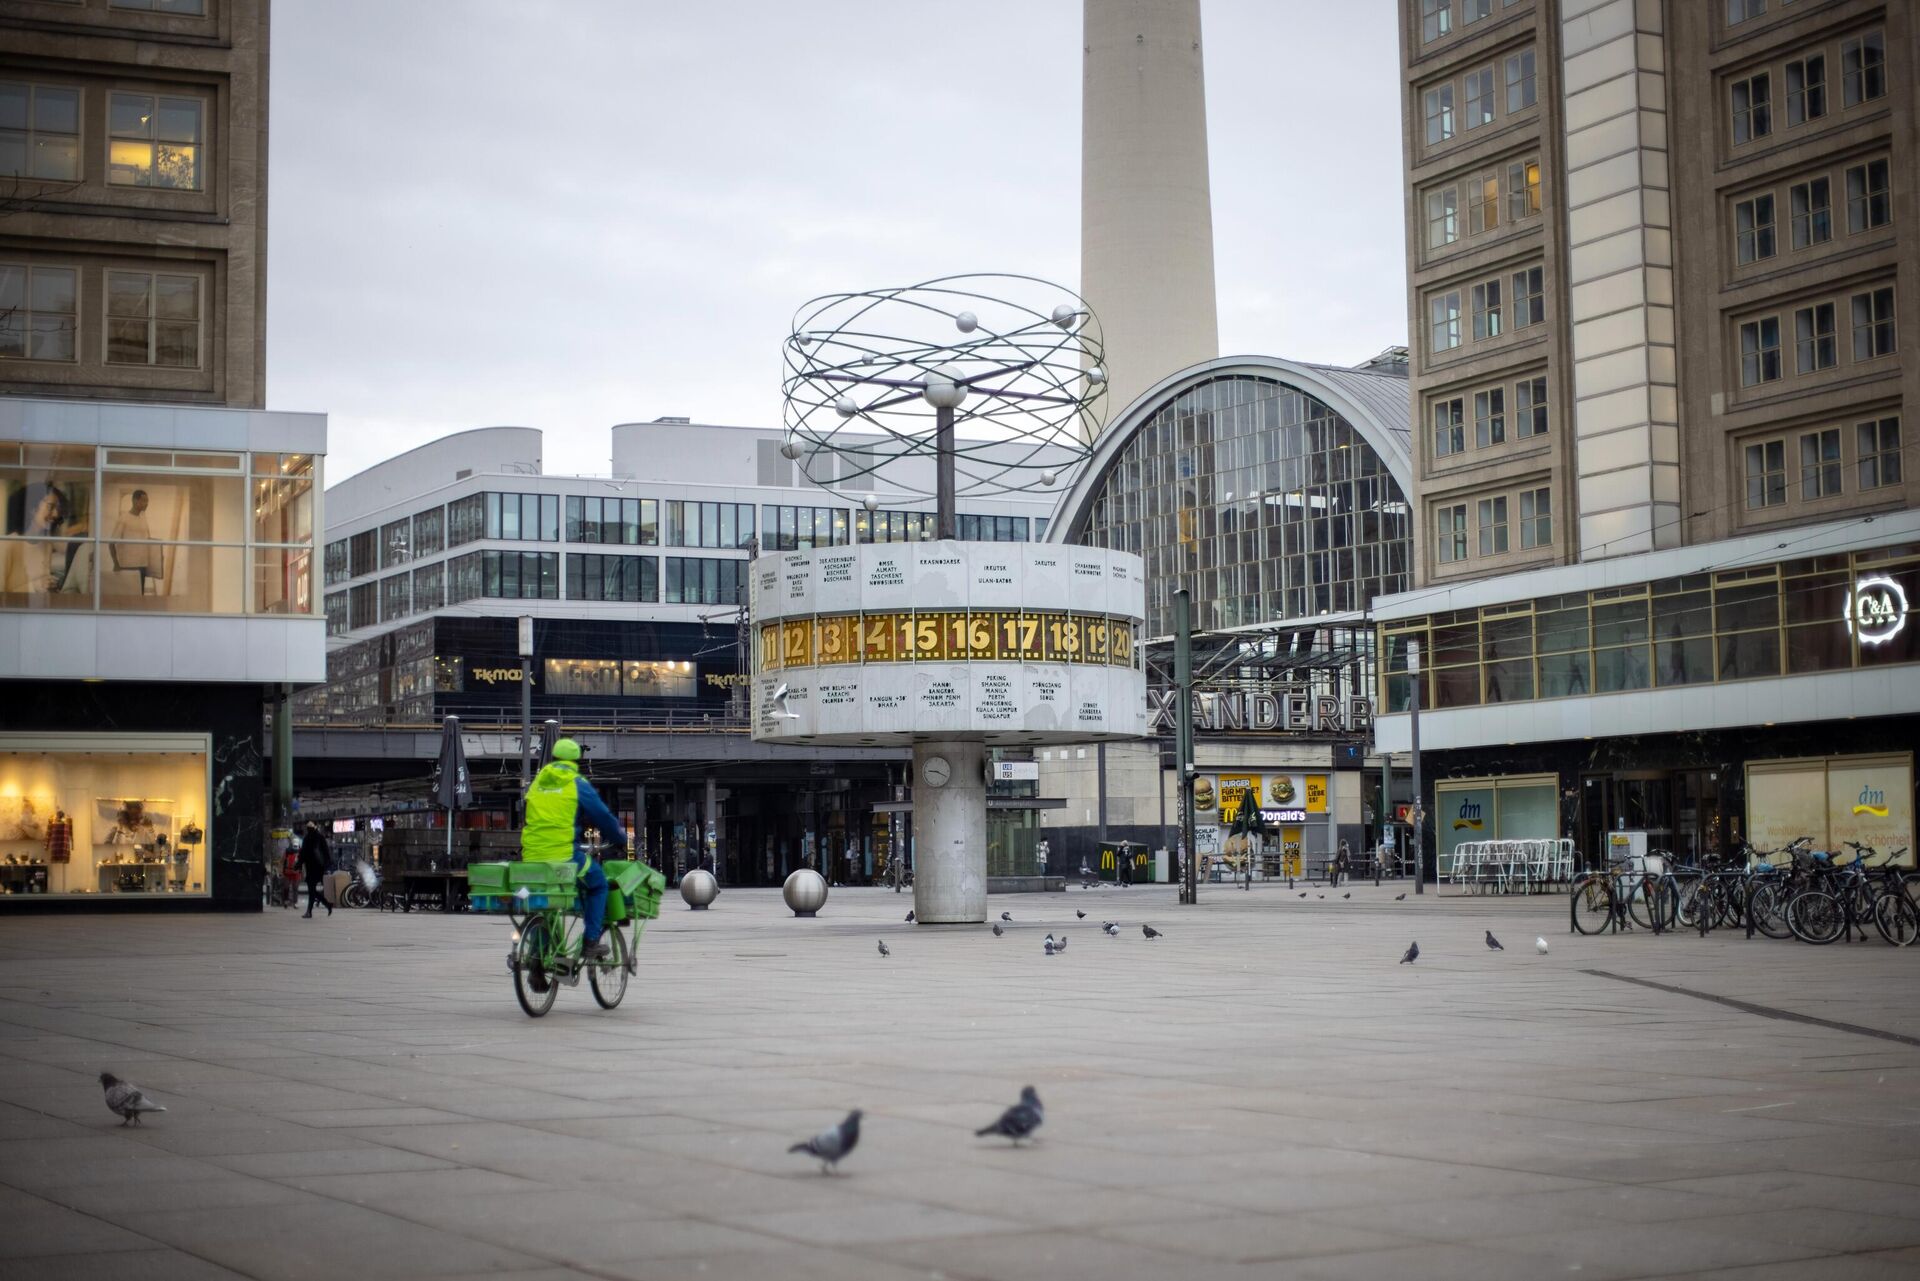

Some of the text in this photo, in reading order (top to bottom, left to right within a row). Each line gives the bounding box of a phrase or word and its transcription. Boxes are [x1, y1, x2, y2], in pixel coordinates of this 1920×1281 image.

[868, 579, 905, 587] NOWOSIBIRSK
[1858, 591, 1898, 625] C&A
[783, 628, 805, 658] 12
[813, 623, 841, 655] 13
[852, 621, 886, 652] 14
[901, 620, 938, 651] 15
[952, 619, 991, 650] 16
[1003, 619, 1039, 650] 17
[1050, 622, 1080, 653] 18
[1087, 624, 1108, 654] 19
[1113, 627, 1130, 659] 20
[1221, 780, 1250, 789] BURGER
[1236, 786, 1259, 795] MITE?
[1859, 785, 1884, 805] dm
[1459, 798, 1481, 819] dm
